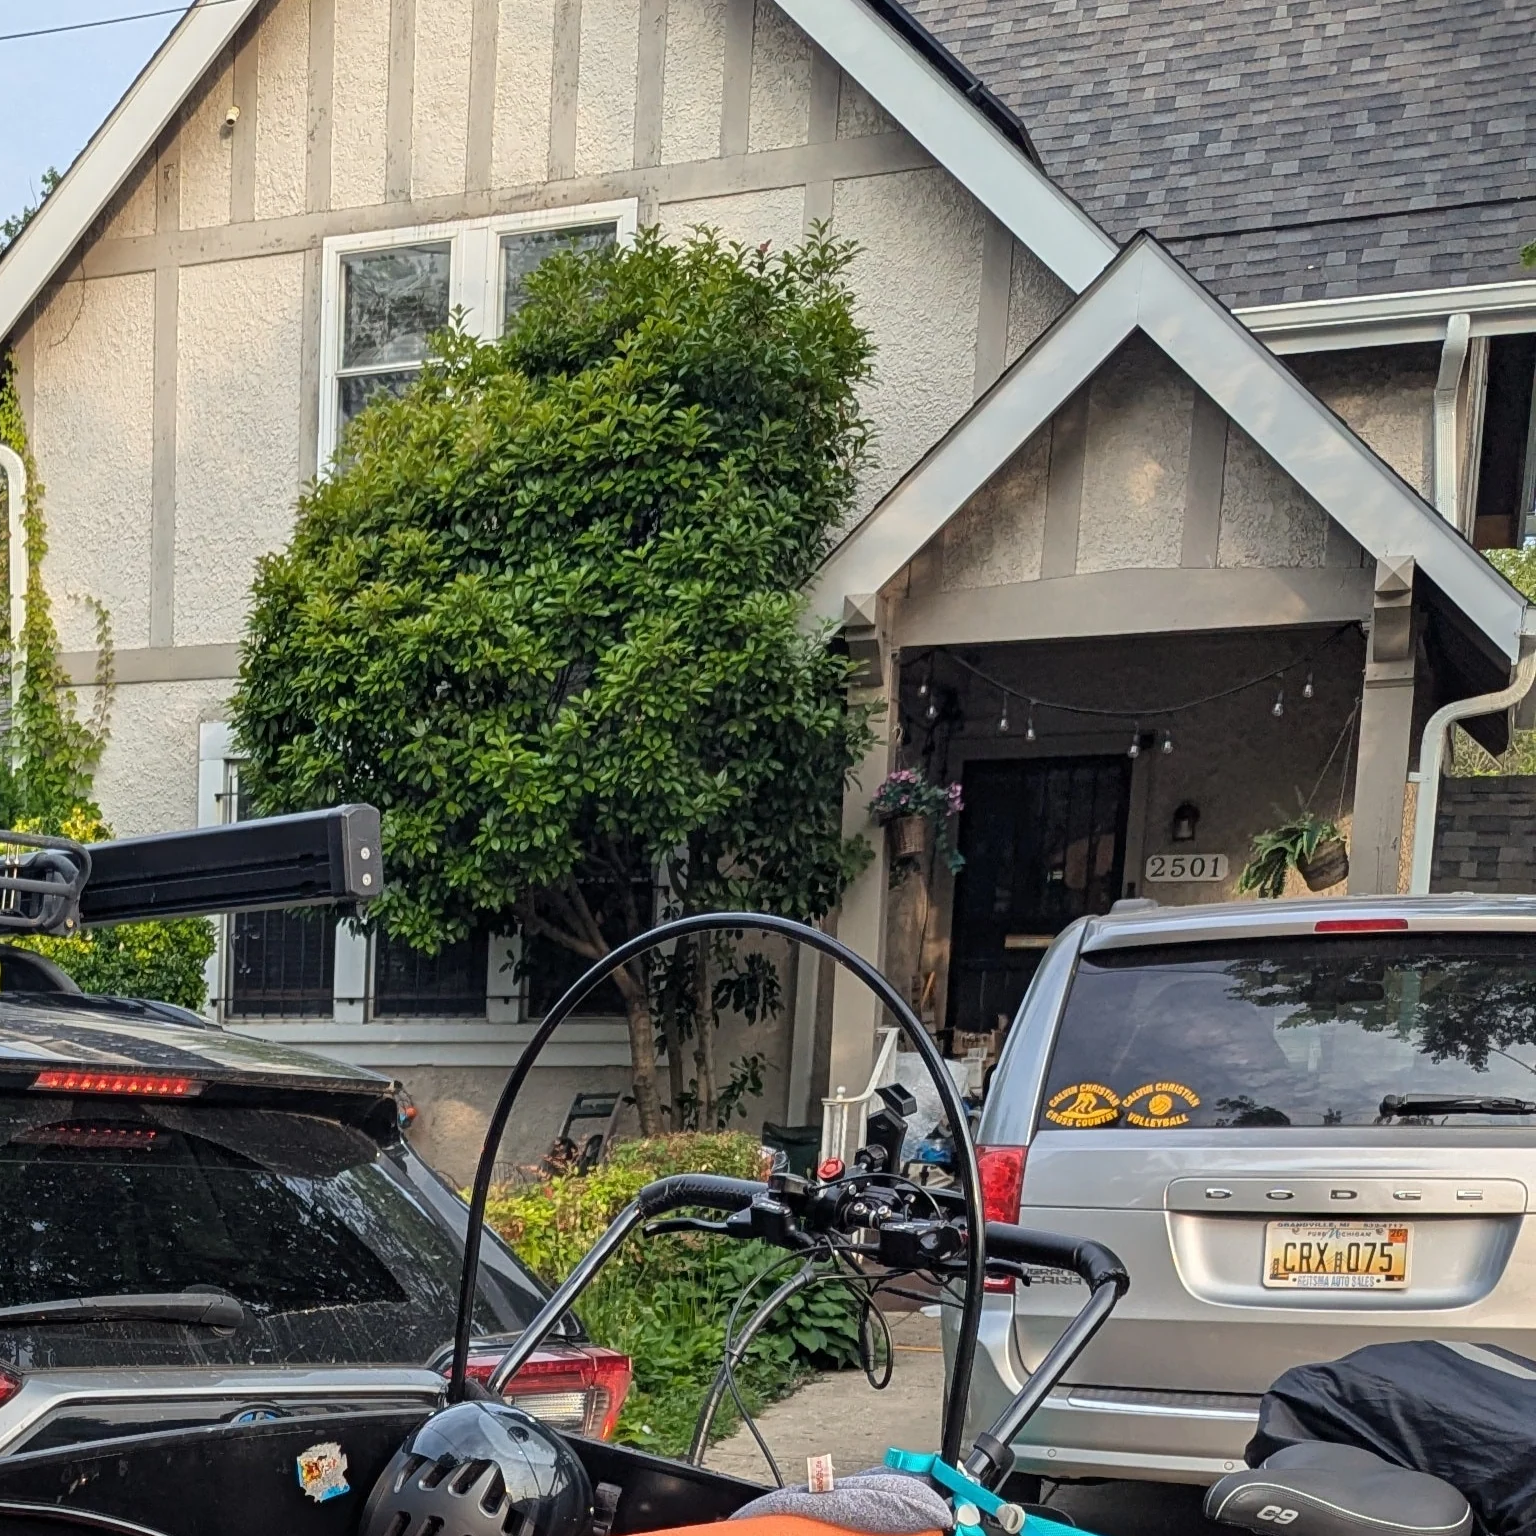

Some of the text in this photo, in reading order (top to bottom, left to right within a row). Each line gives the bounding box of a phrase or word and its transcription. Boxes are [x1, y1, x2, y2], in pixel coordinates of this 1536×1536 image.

[1150, 856, 1219, 878] 2501
[1048, 1083, 1121, 1108] CALVIN CHRISTIAN
[1122, 1082, 1201, 1108] CALVIN CHRISTIAN
[1045, 1108, 1119, 1128] CROSS COUNTRY
[1126, 1112, 1190, 1128] VOLLEYBALL
[1205, 1187, 1484, 1201] DODGE
[1283, 1242, 1394, 1273] CRX 075
[1331, 1276, 1350, 1287] AUTO
[1352, 1276, 1375, 1288] SALES
